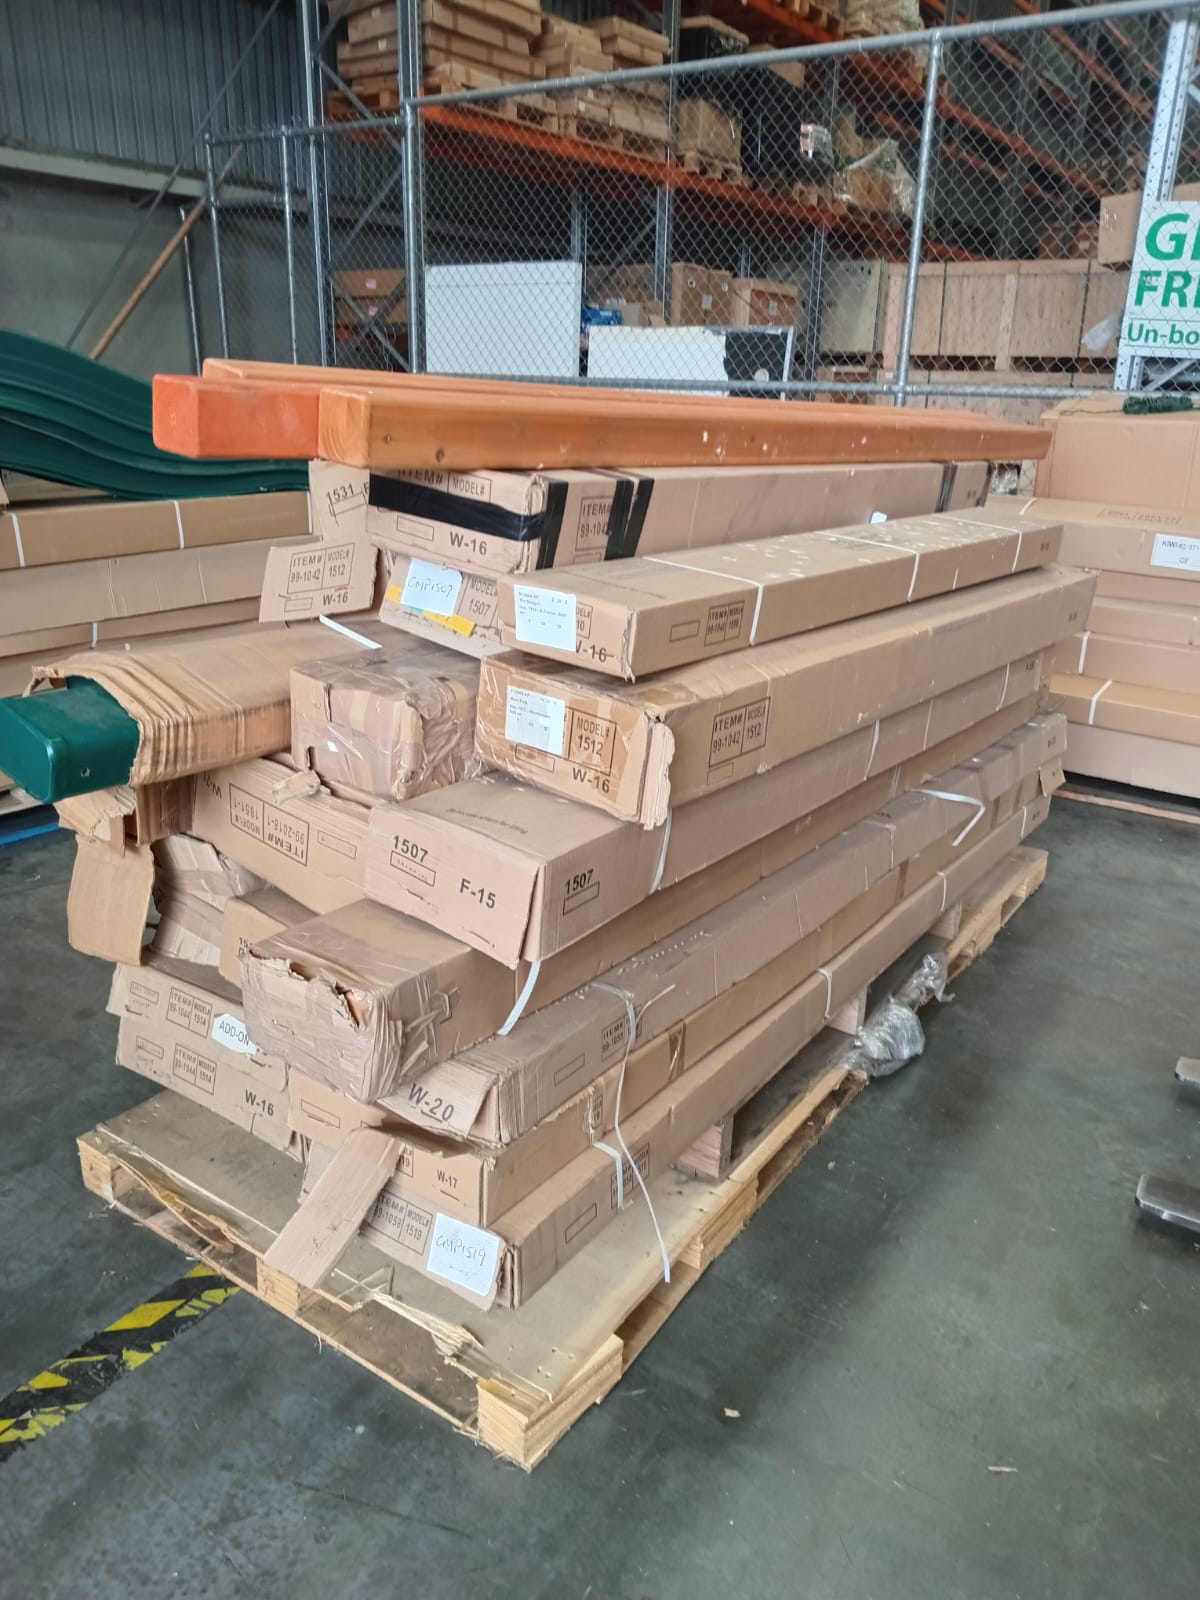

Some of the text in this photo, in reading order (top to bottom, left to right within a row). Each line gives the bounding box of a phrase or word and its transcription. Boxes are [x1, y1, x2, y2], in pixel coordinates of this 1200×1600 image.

[1145, 212, 1200, 260] G
[327, 483, 354, 502] 1531
[452, 477, 486, 496] MODEL#
[450, 531, 487, 556] W-16
[292, 549, 350, 568] ITEM# MODEL#
[290, 564, 346, 583] 99-1042 1512
[322, 591, 349, 607] W-16
[469, 599, 491, 617] 1507
[576, 716, 610, 739] MODEL#
[714, 711, 743, 734] ITEM#
[577, 734, 605, 757] 1512
[712, 722, 762, 753] 99-1042 1512
[572, 767, 610, 794] W-16
[233, 812, 305, 859] ITEM# MODEL#
[393, 834, 429, 865] 1507
[564, 868, 595, 895] 1507
[459, 877, 497, 910] F-15
[171, 992, 193, 1007] ITEM#
[194, 1013, 208, 1027] 1514
[218, 1020, 249, 1047] ADD-ON
[175, 1047, 197, 1063] ITEM#
[199, 1070, 212, 1085] 1514
[245, 1088, 275, 1117] W-16
[408, 1083, 454, 1121] W-20
[437, 1169, 458, 1190] W-17
[407, 1209, 430, 1228] MODEL#
[405, 1223, 422, 1241] 1519
